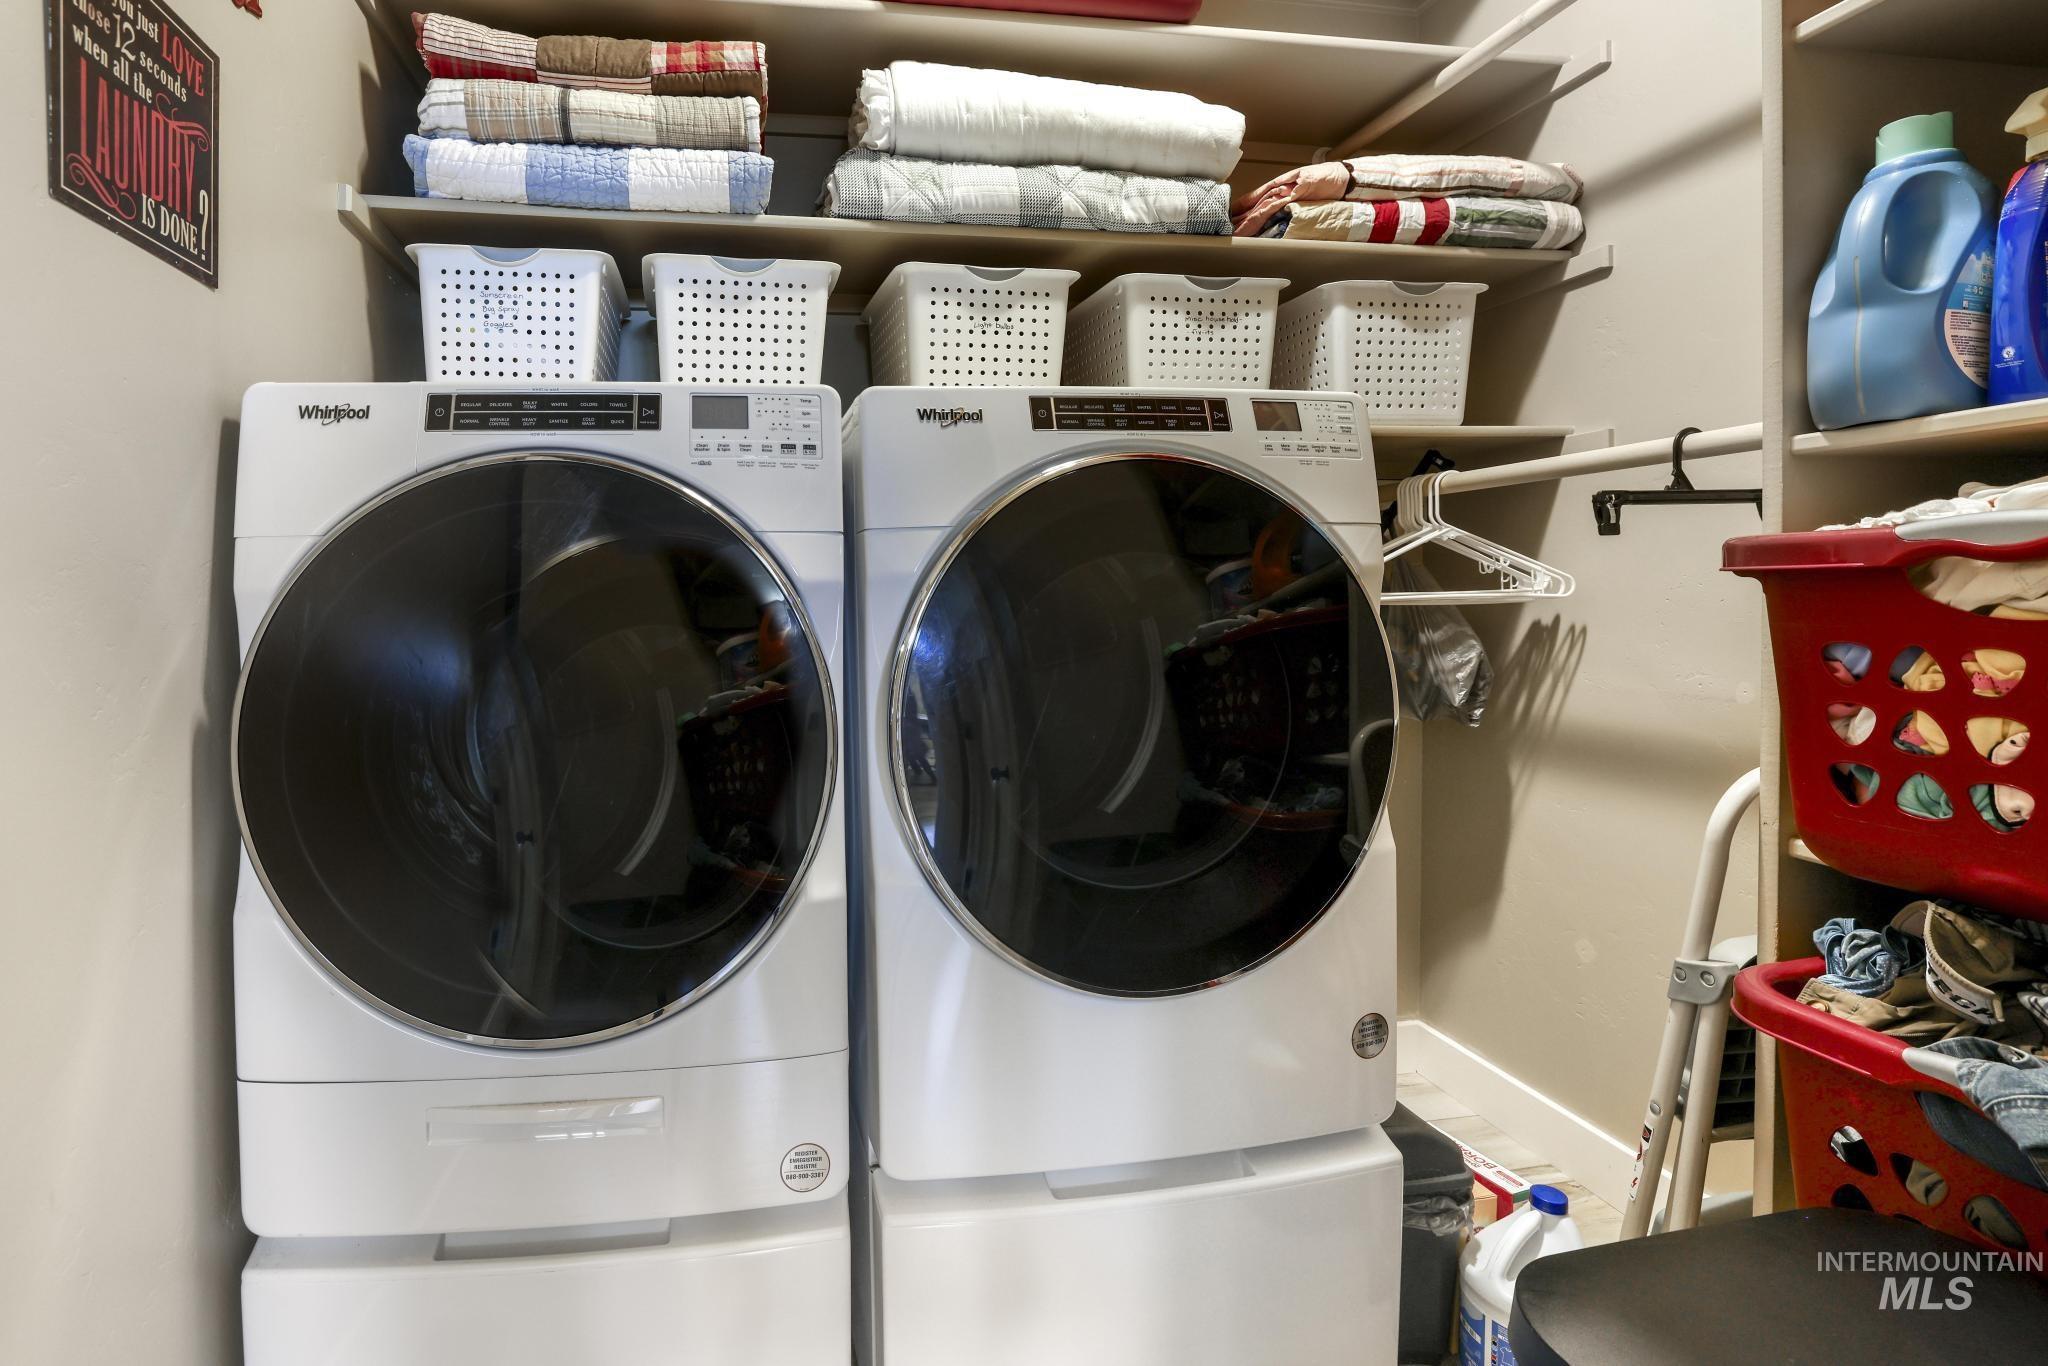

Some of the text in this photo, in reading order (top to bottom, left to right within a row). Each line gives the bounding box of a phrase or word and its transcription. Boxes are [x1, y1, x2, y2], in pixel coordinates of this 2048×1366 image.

[72, 24, 152, 104] when all the
[112, 13, 136, 61] 12
[139, 51, 188, 103] seconds
[136, 4, 160, 43] just
[162, 22, 204, 97] LOVE
[70, 57, 205, 221] LAUNDRY
[141, 193, 156, 229] IS
[482, 305, 520, 315] Bug Spray
[483, 320, 514, 329] Goggles
[298, 403, 371, 424] Whirlpool
[916, 408, 983, 425] Whirlpool
